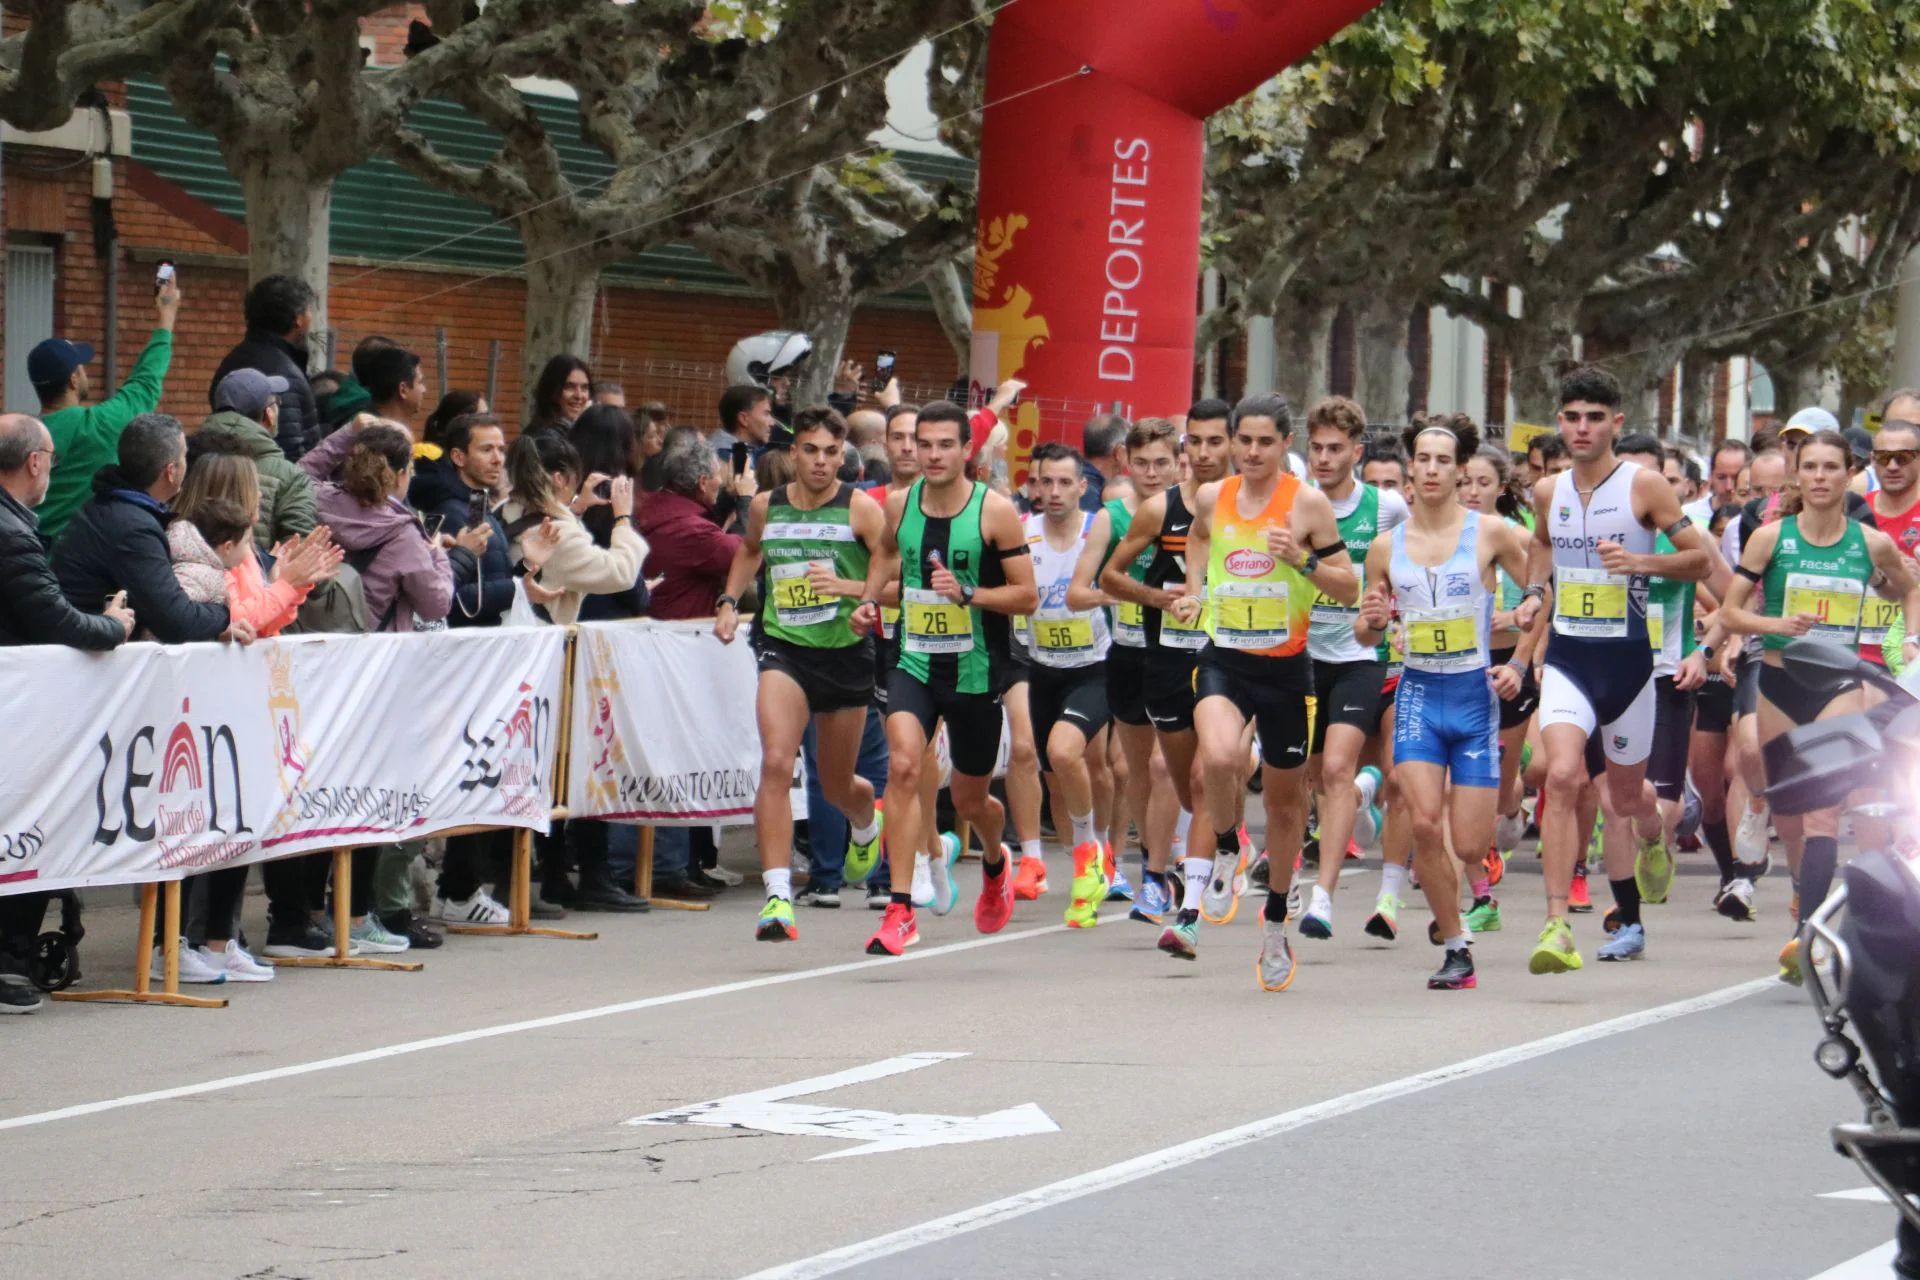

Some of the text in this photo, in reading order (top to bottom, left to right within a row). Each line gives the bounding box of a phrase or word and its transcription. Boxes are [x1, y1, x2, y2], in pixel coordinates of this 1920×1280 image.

[1098, 137, 1150, 382] DEPORTES
[1228, 557, 1271, 570] Serrano
[788, 585, 820, 607] 134
[1583, 593, 1594, 616] 6
[1248, 606, 1252, 629] 1
[1817, 600, 1829, 623] 11
[923, 612, 948, 634] 26
[1049, 627, 1072, 647] 56
[1434, 630, 1447, 652] 9
